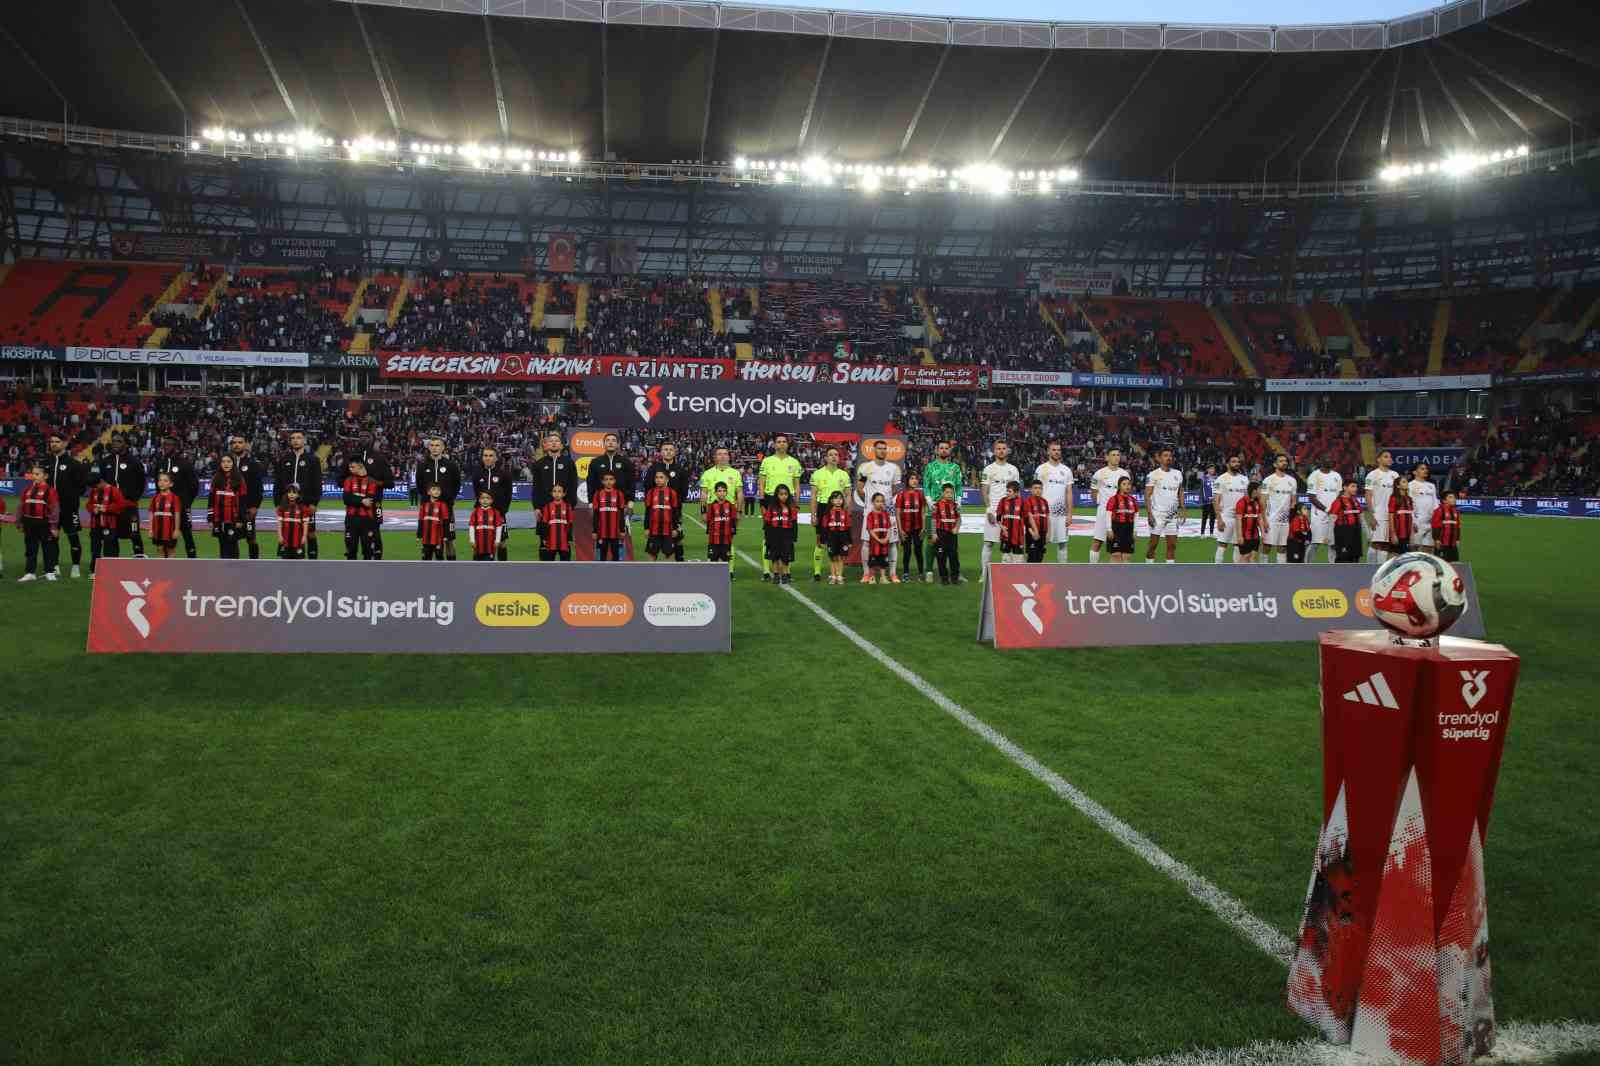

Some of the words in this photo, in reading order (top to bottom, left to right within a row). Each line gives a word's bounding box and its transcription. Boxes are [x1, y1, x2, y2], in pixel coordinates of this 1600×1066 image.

[1, 349, 56, 360] HOSPITAL
[338, 355, 379, 367] ARENA
[667, 391, 771, 418] trendyol
[182, 590, 333, 624] trendyol
[568, 602, 628, 617] trendyol
[1065, 589, 1184, 619] trendyol
[1438, 710, 1499, 726] trendyol
